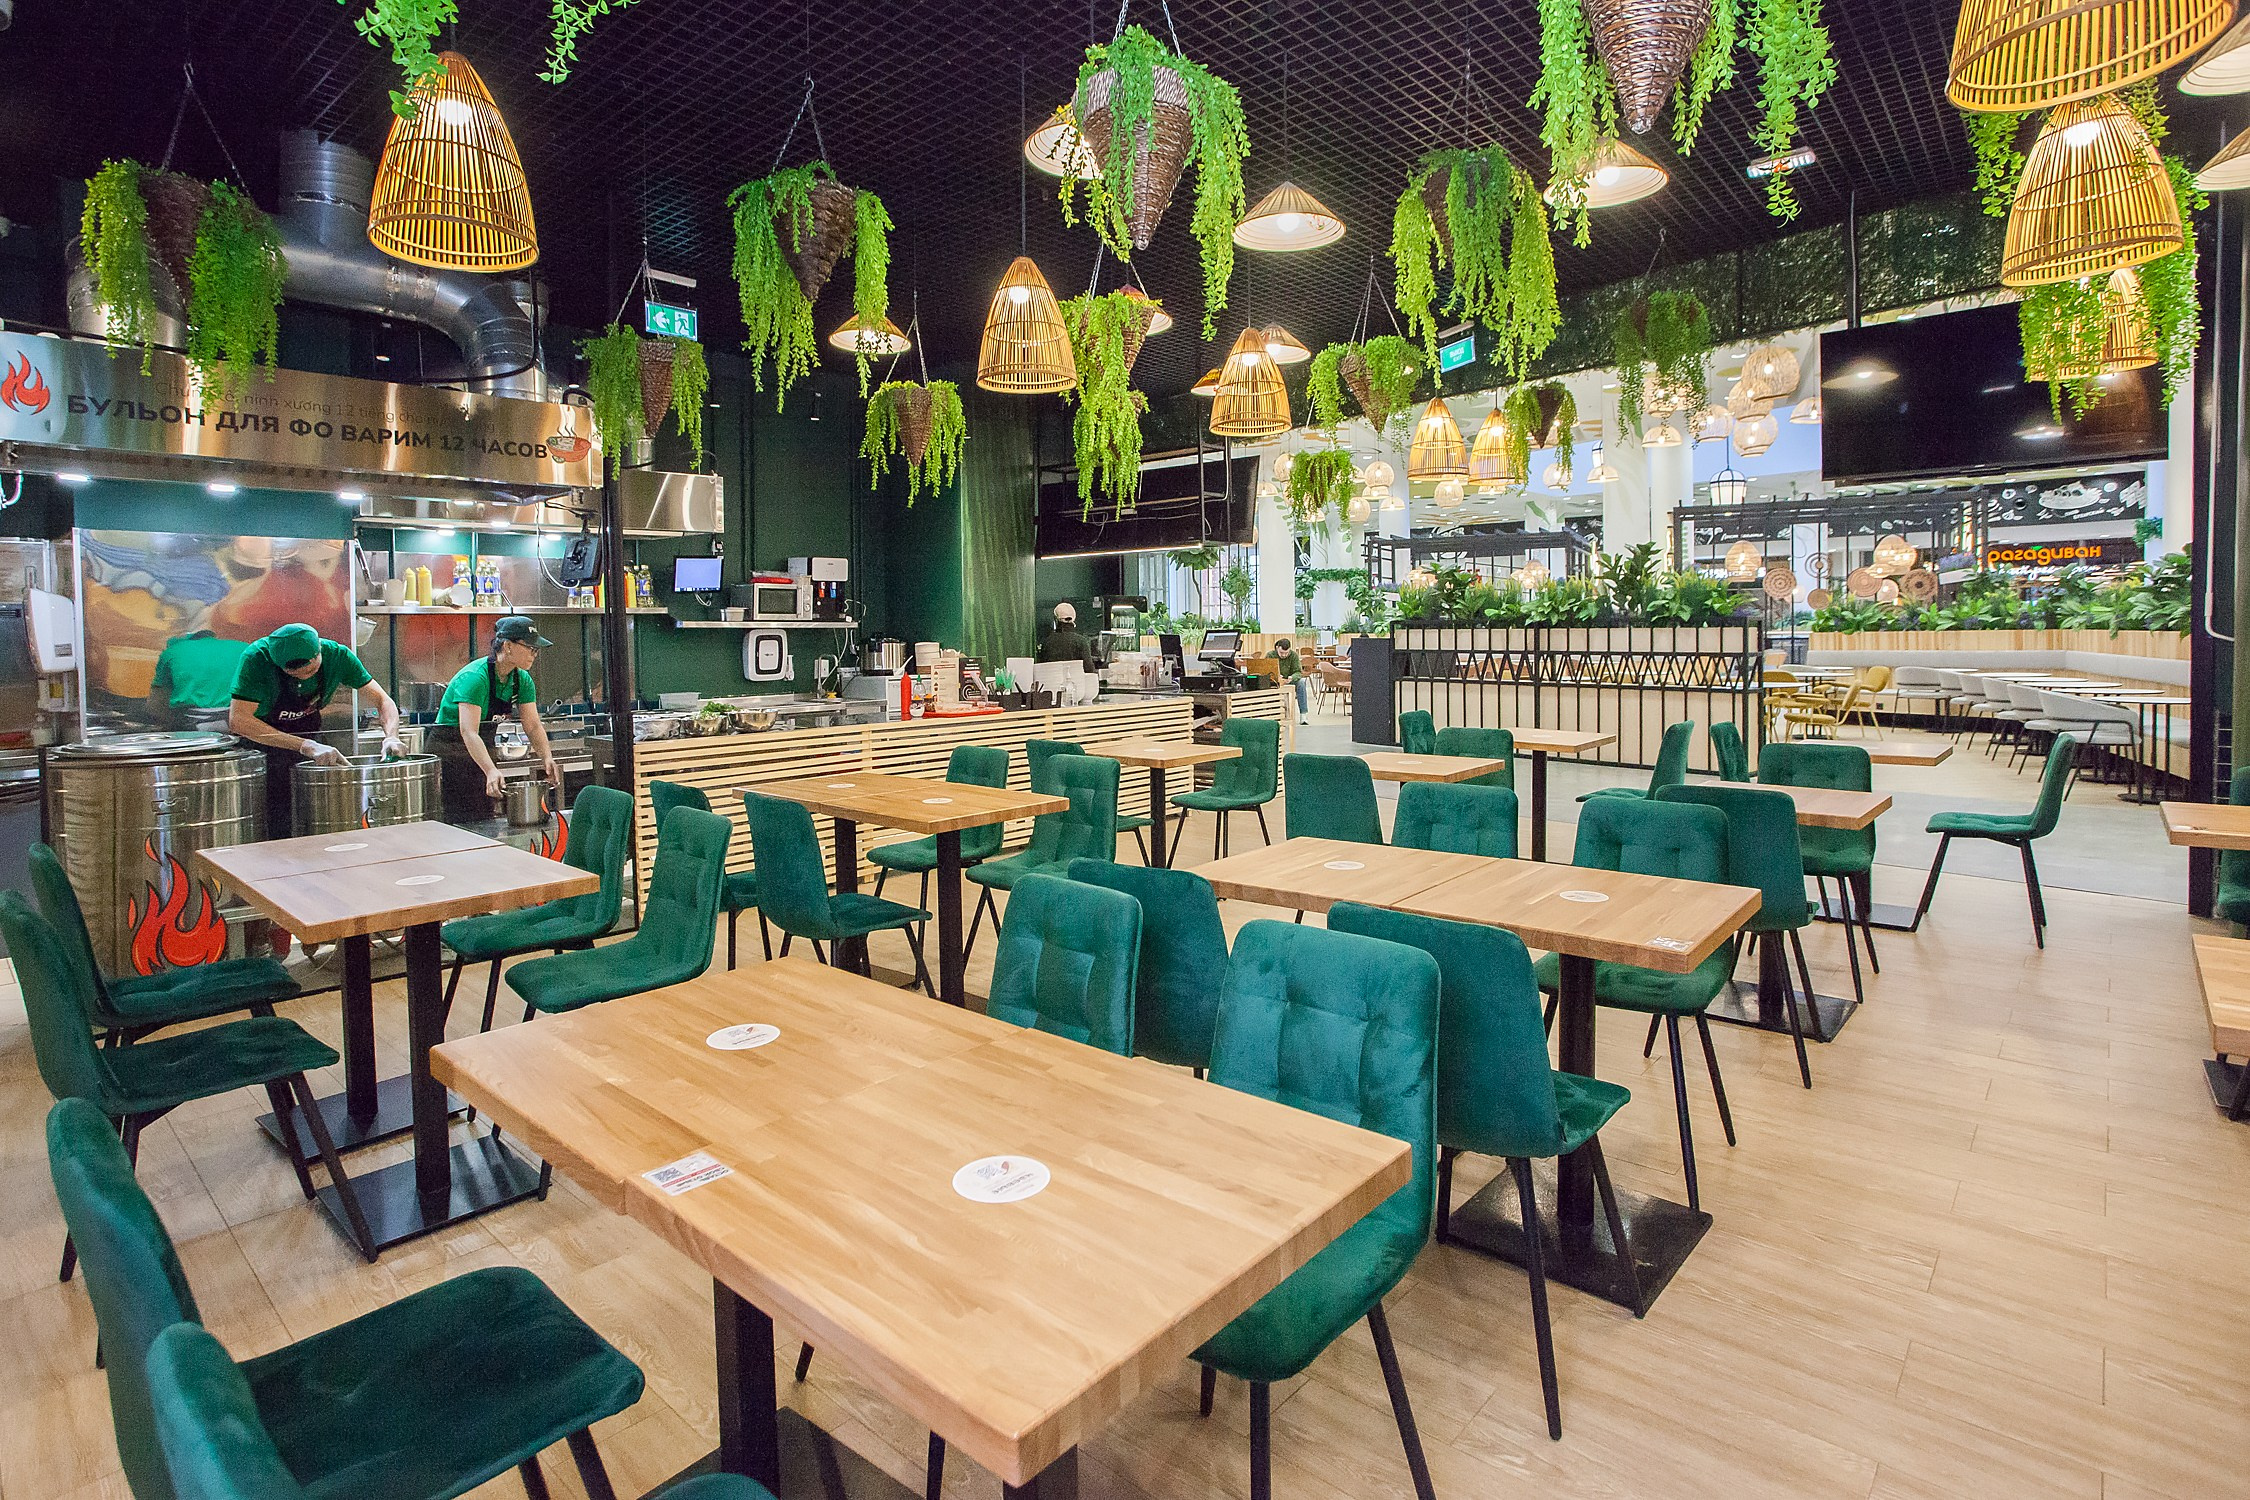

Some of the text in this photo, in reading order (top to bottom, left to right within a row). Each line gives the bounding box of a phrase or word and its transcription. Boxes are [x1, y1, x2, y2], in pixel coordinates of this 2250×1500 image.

[68, 395, 206, 426] БУЛЬОН
[215, 411, 279, 434] ДЛЯ
[289, 418, 333, 439] ФО
[341, 424, 431, 449] ВАРИМ
[440, 435, 465, 452] 12
[472, 438, 548, 460] ЧАСОВ
[338, 404, 354, 417] 12
